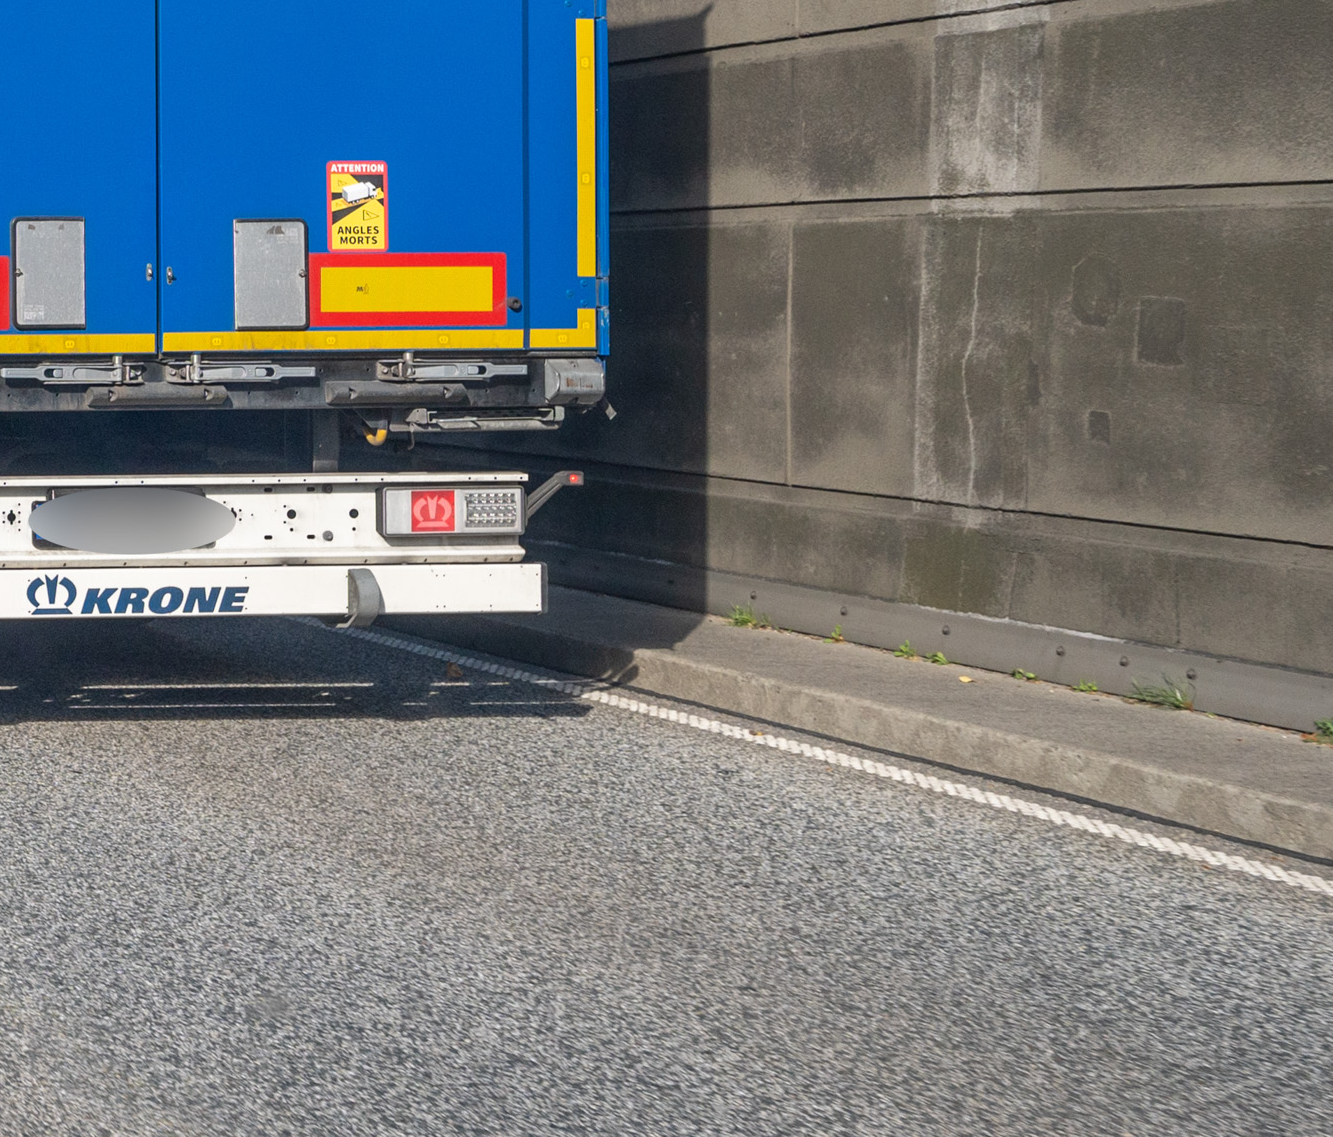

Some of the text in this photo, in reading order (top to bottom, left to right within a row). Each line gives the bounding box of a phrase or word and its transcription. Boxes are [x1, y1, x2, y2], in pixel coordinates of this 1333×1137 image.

[331, 164, 384, 173] ATTENTION
[337, 226, 379, 235] ANGLES
[340, 236, 378, 245] MORTS
[80, 586, 250, 614] KRONE
